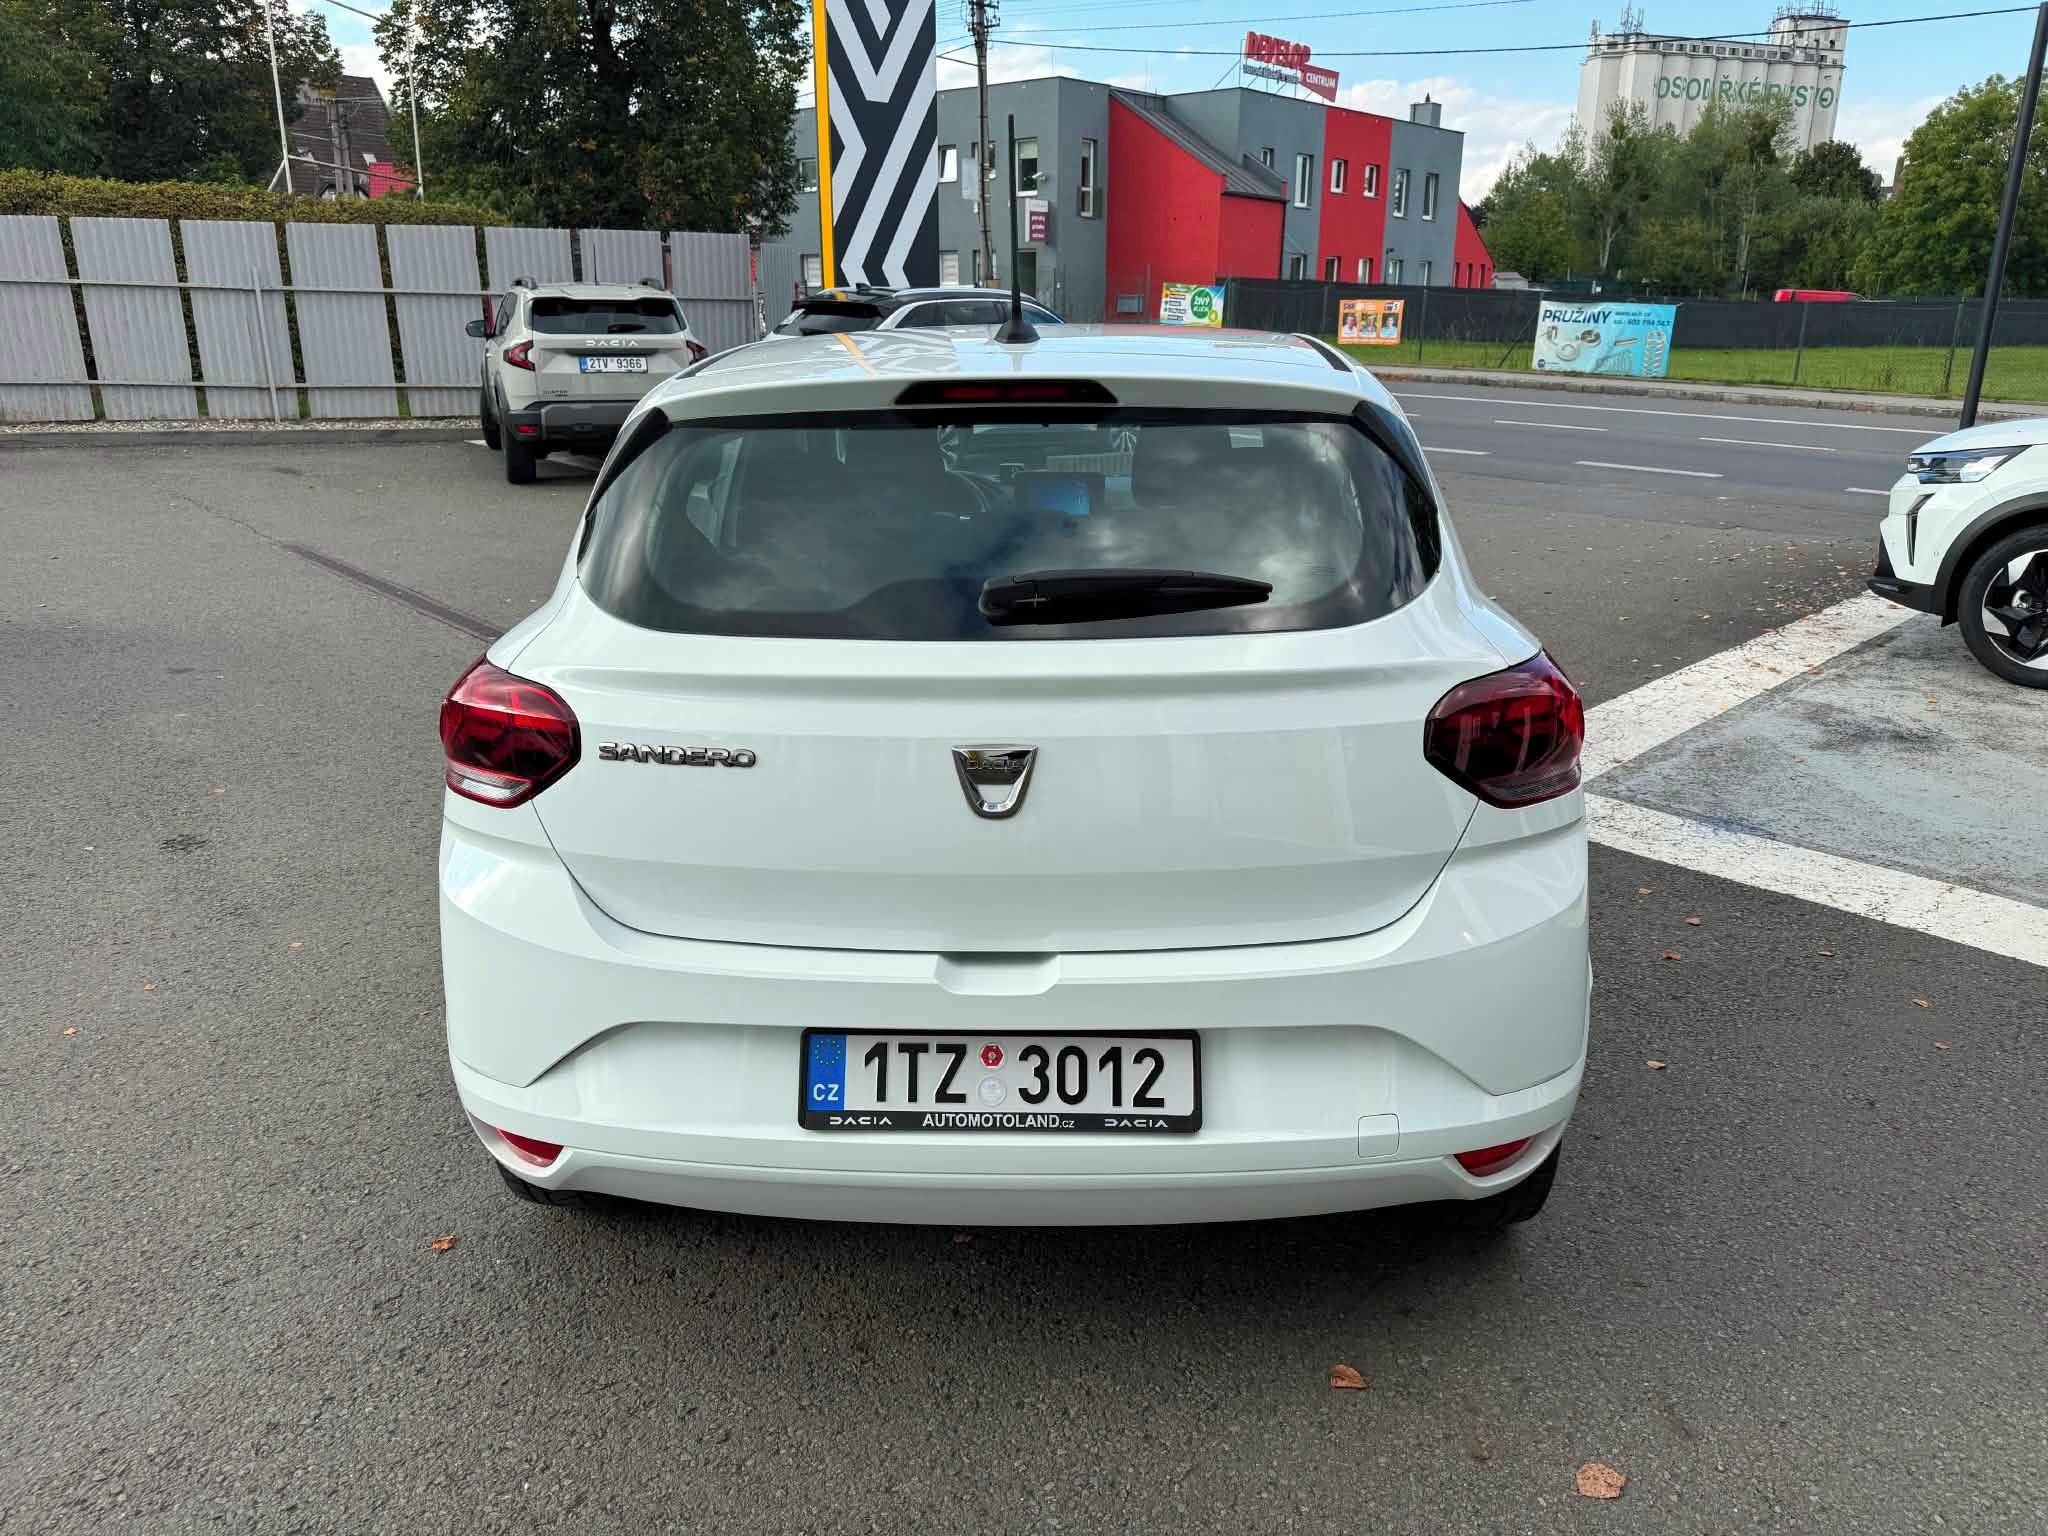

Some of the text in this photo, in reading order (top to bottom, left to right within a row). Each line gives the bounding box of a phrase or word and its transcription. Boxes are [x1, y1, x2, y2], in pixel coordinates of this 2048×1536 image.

[1305, 72, 1336, 88] CENTRUM
[1542, 307, 1612, 324] PRUŽINY
[584, 339, 639, 347] DACIA
[590, 358, 642, 369] 2TV 9366
[599, 741, 757, 768] SANDERO
[864, 1041, 1166, 1108] 1TZ 3012
[813, 1083, 839, 1101] CZ
[829, 1116, 892, 1125] DACIA
[1104, 1118, 1168, 1128] DACIA
